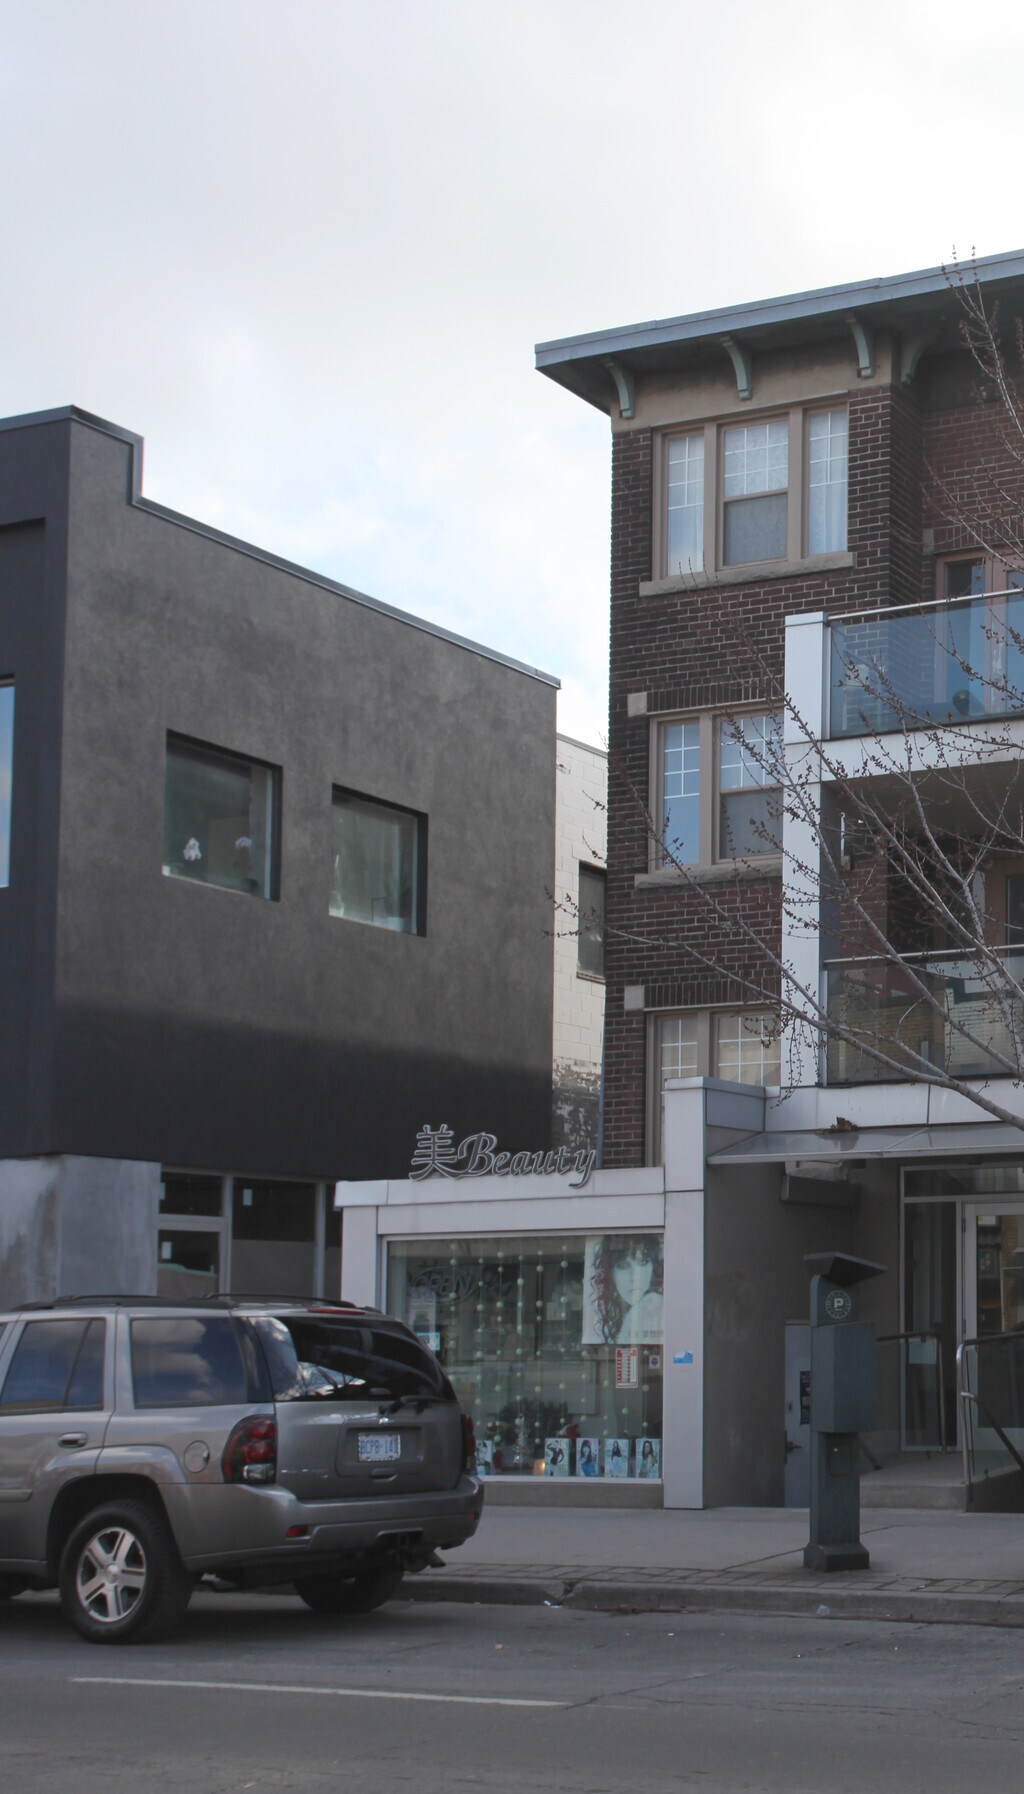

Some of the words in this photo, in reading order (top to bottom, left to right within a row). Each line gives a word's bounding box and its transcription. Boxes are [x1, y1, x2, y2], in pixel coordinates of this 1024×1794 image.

[408, 1124, 459, 1181] 美
[457, 1131, 596, 1188] Beauty
[413, 1272, 473, 1298] OPEN
[834, 1298, 844, 1308] P
